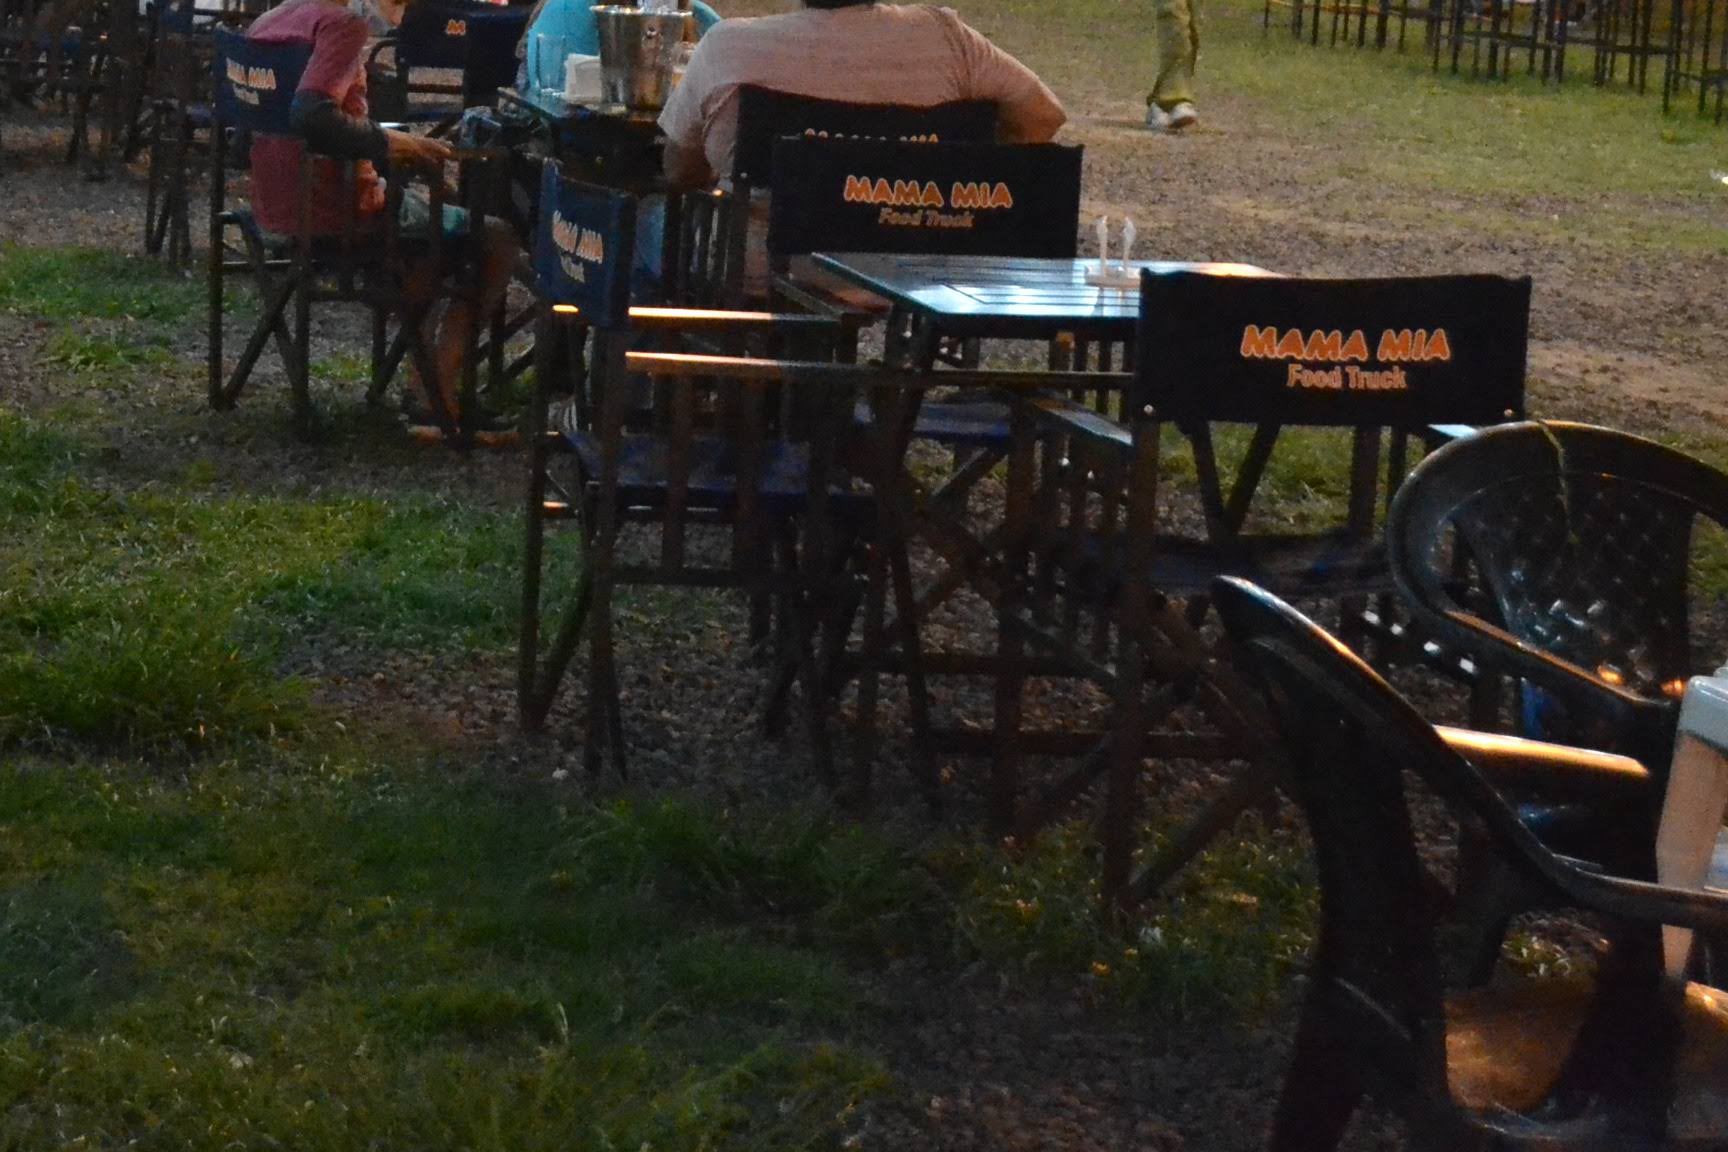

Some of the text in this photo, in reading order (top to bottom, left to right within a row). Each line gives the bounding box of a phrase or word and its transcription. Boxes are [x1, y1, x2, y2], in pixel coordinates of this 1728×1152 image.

[844, 174, 1014, 209] MAMA MIA
[878, 207, 975, 229] Food Truck
[1239, 323, 1452, 363] MAMA MIA
[1286, 363, 1408, 390] Food Truck
